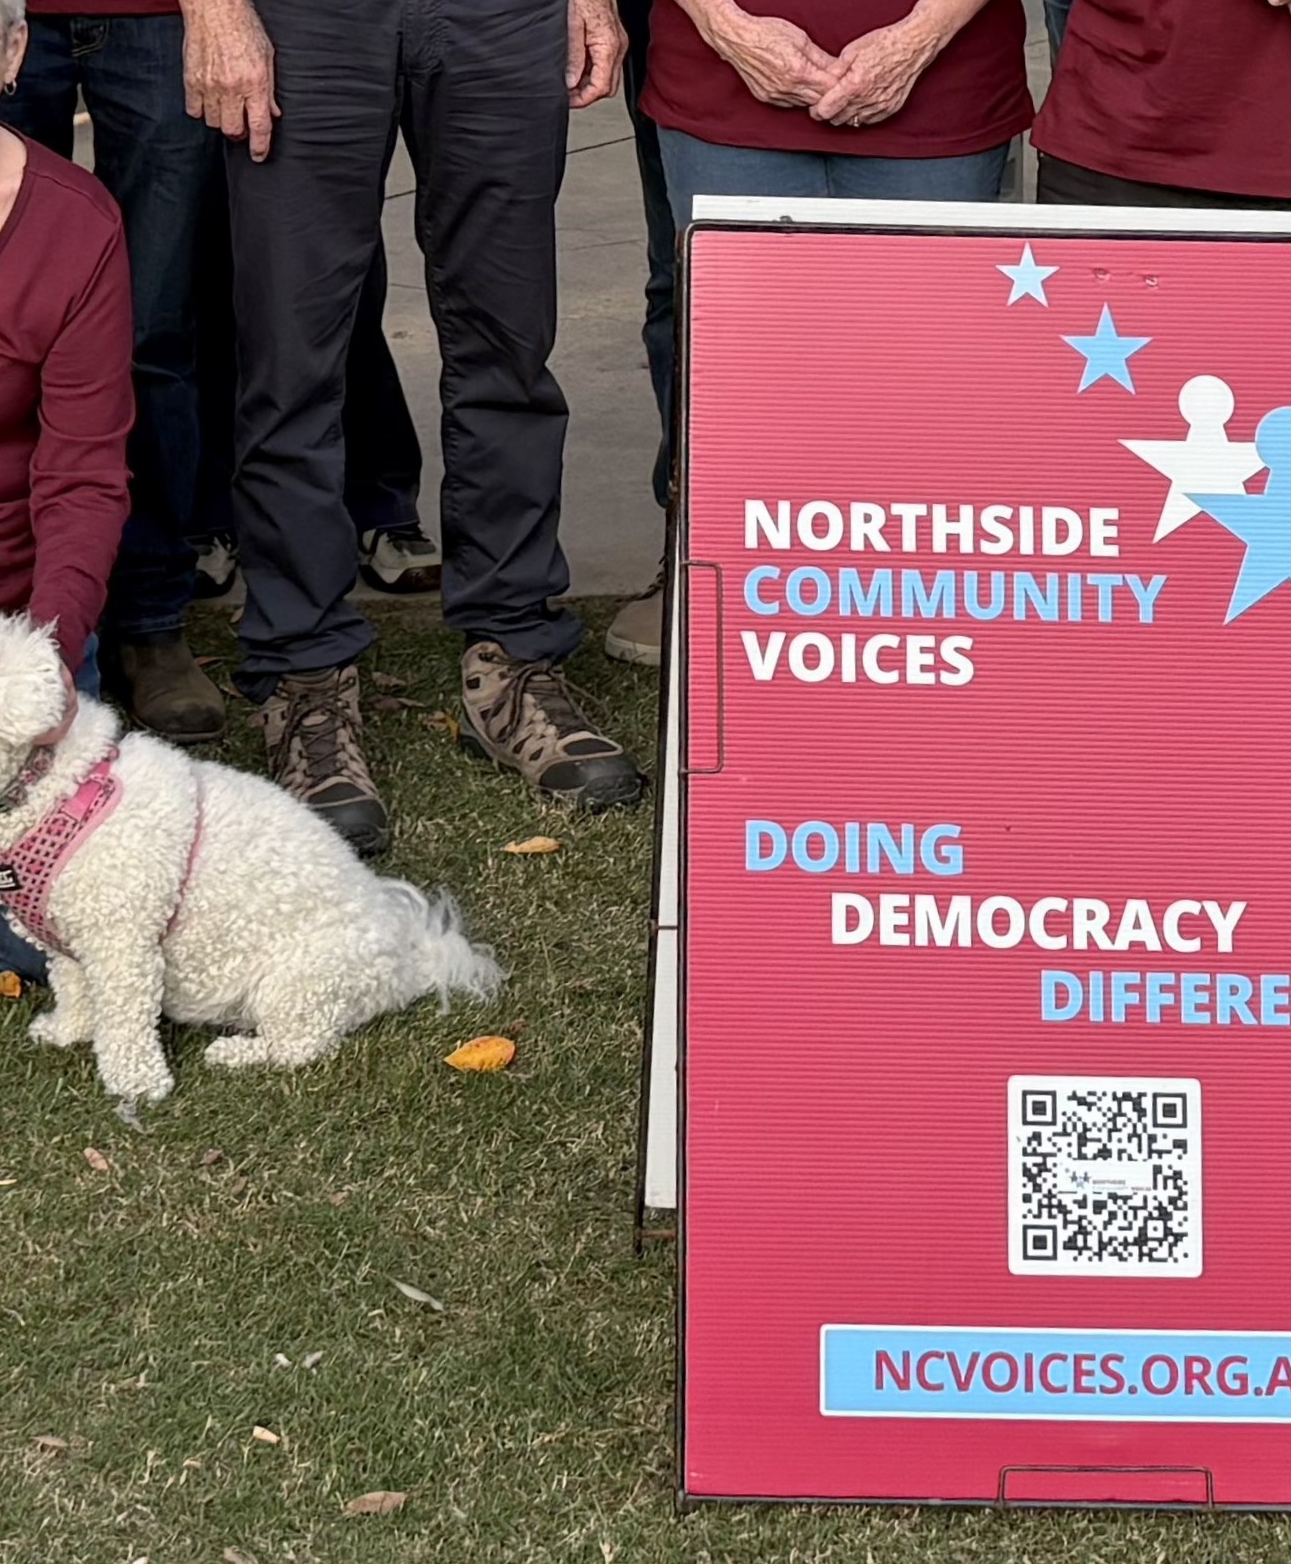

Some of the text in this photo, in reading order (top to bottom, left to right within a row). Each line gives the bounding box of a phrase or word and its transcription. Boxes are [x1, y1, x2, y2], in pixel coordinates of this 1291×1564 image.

[743, 499, 1121, 557] NORTHSIDE
[742, 565, 1168, 624] COMMUNITY
[740, 630, 976, 686] VOICES
[744, 819, 965, 875] DOING
[830, 892, 1247, 953] DEMOCRACY
